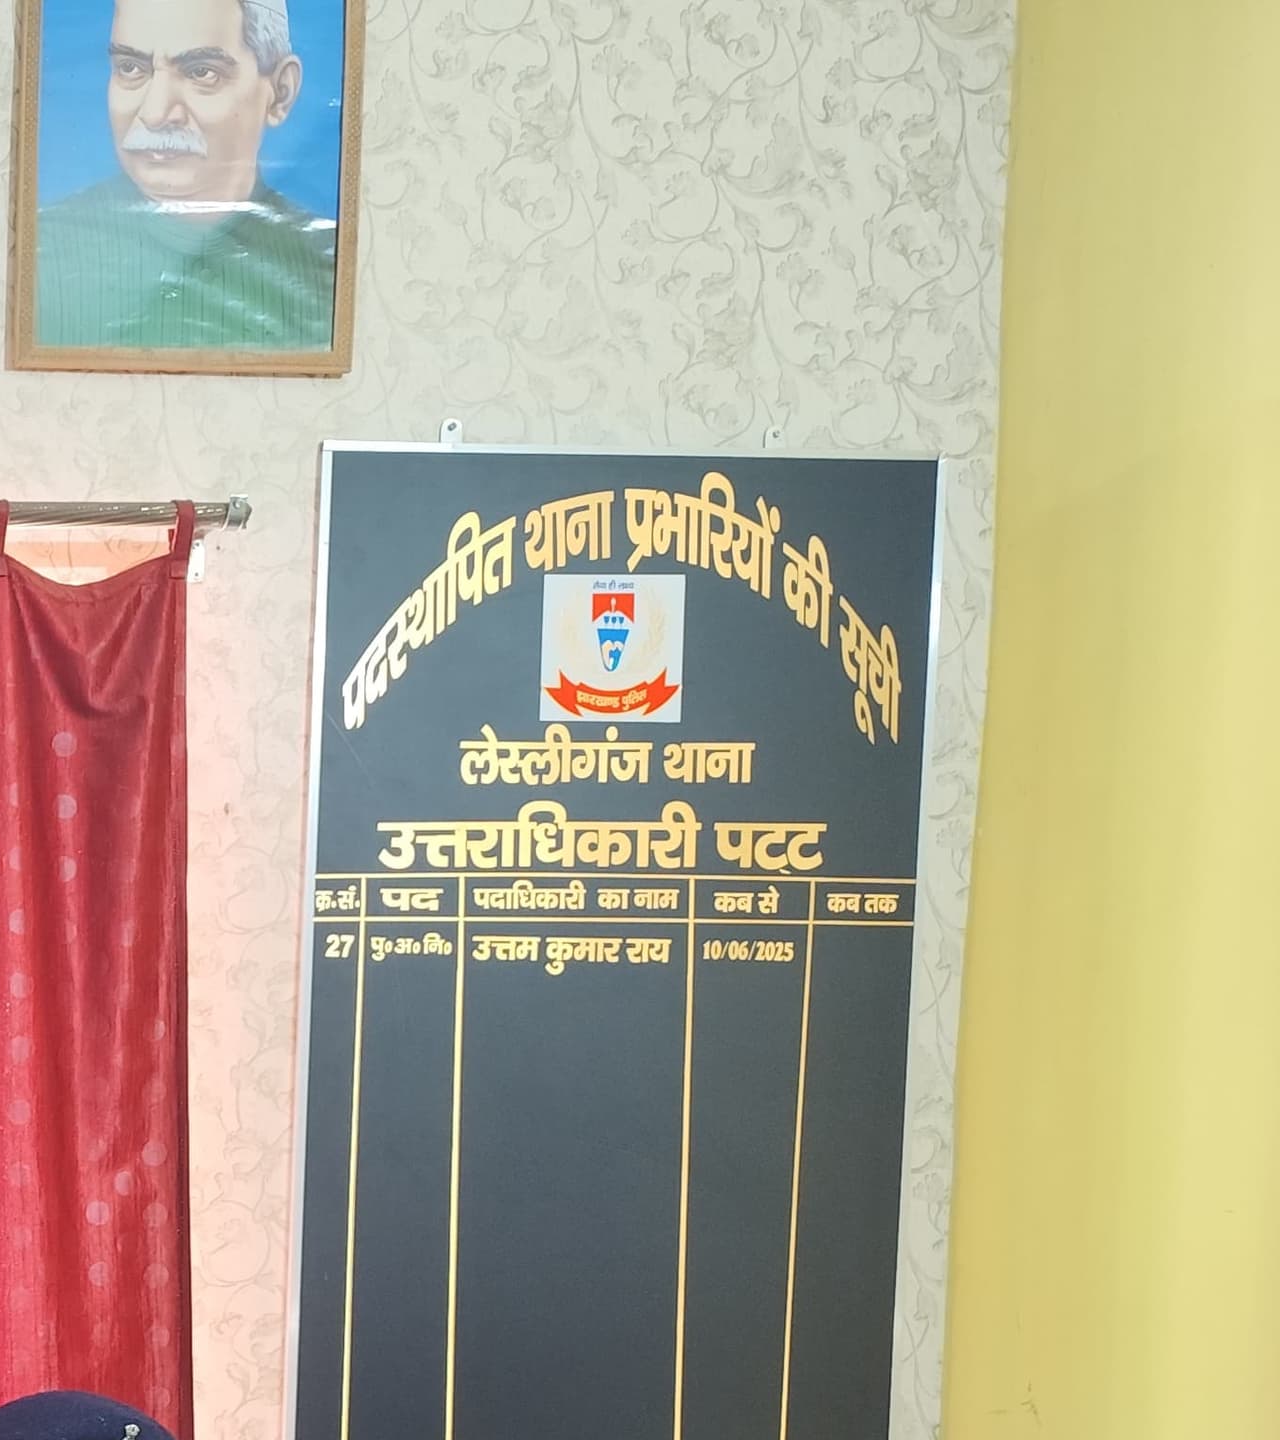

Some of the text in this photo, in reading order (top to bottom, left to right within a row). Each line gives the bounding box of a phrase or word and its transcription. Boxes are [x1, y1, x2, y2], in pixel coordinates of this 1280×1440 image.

[342, 512, 517, 731] पदस्थापित
[526, 492, 613, 569] थाना
[618, 473, 780, 605] प्रभारियों
[784, 538, 833, 644] की
[621, 688, 648, 711] पुलिस
[465, 725, 754, 783] लेस्लीगंज थाना
[377, 801, 701, 870] उत्तराधिकारी
[382, 886, 443, 910] पद
[476, 879, 678, 908] पदाधिकारी का नाम
[716, 888, 779, 913] कब से
[828, 894, 898, 913] कब तक
[325, 935, 354, 960] 27
[475, 936, 671, 973] उत्तम कुमार राय
[703, 938, 794, 963] 10/06/2025
